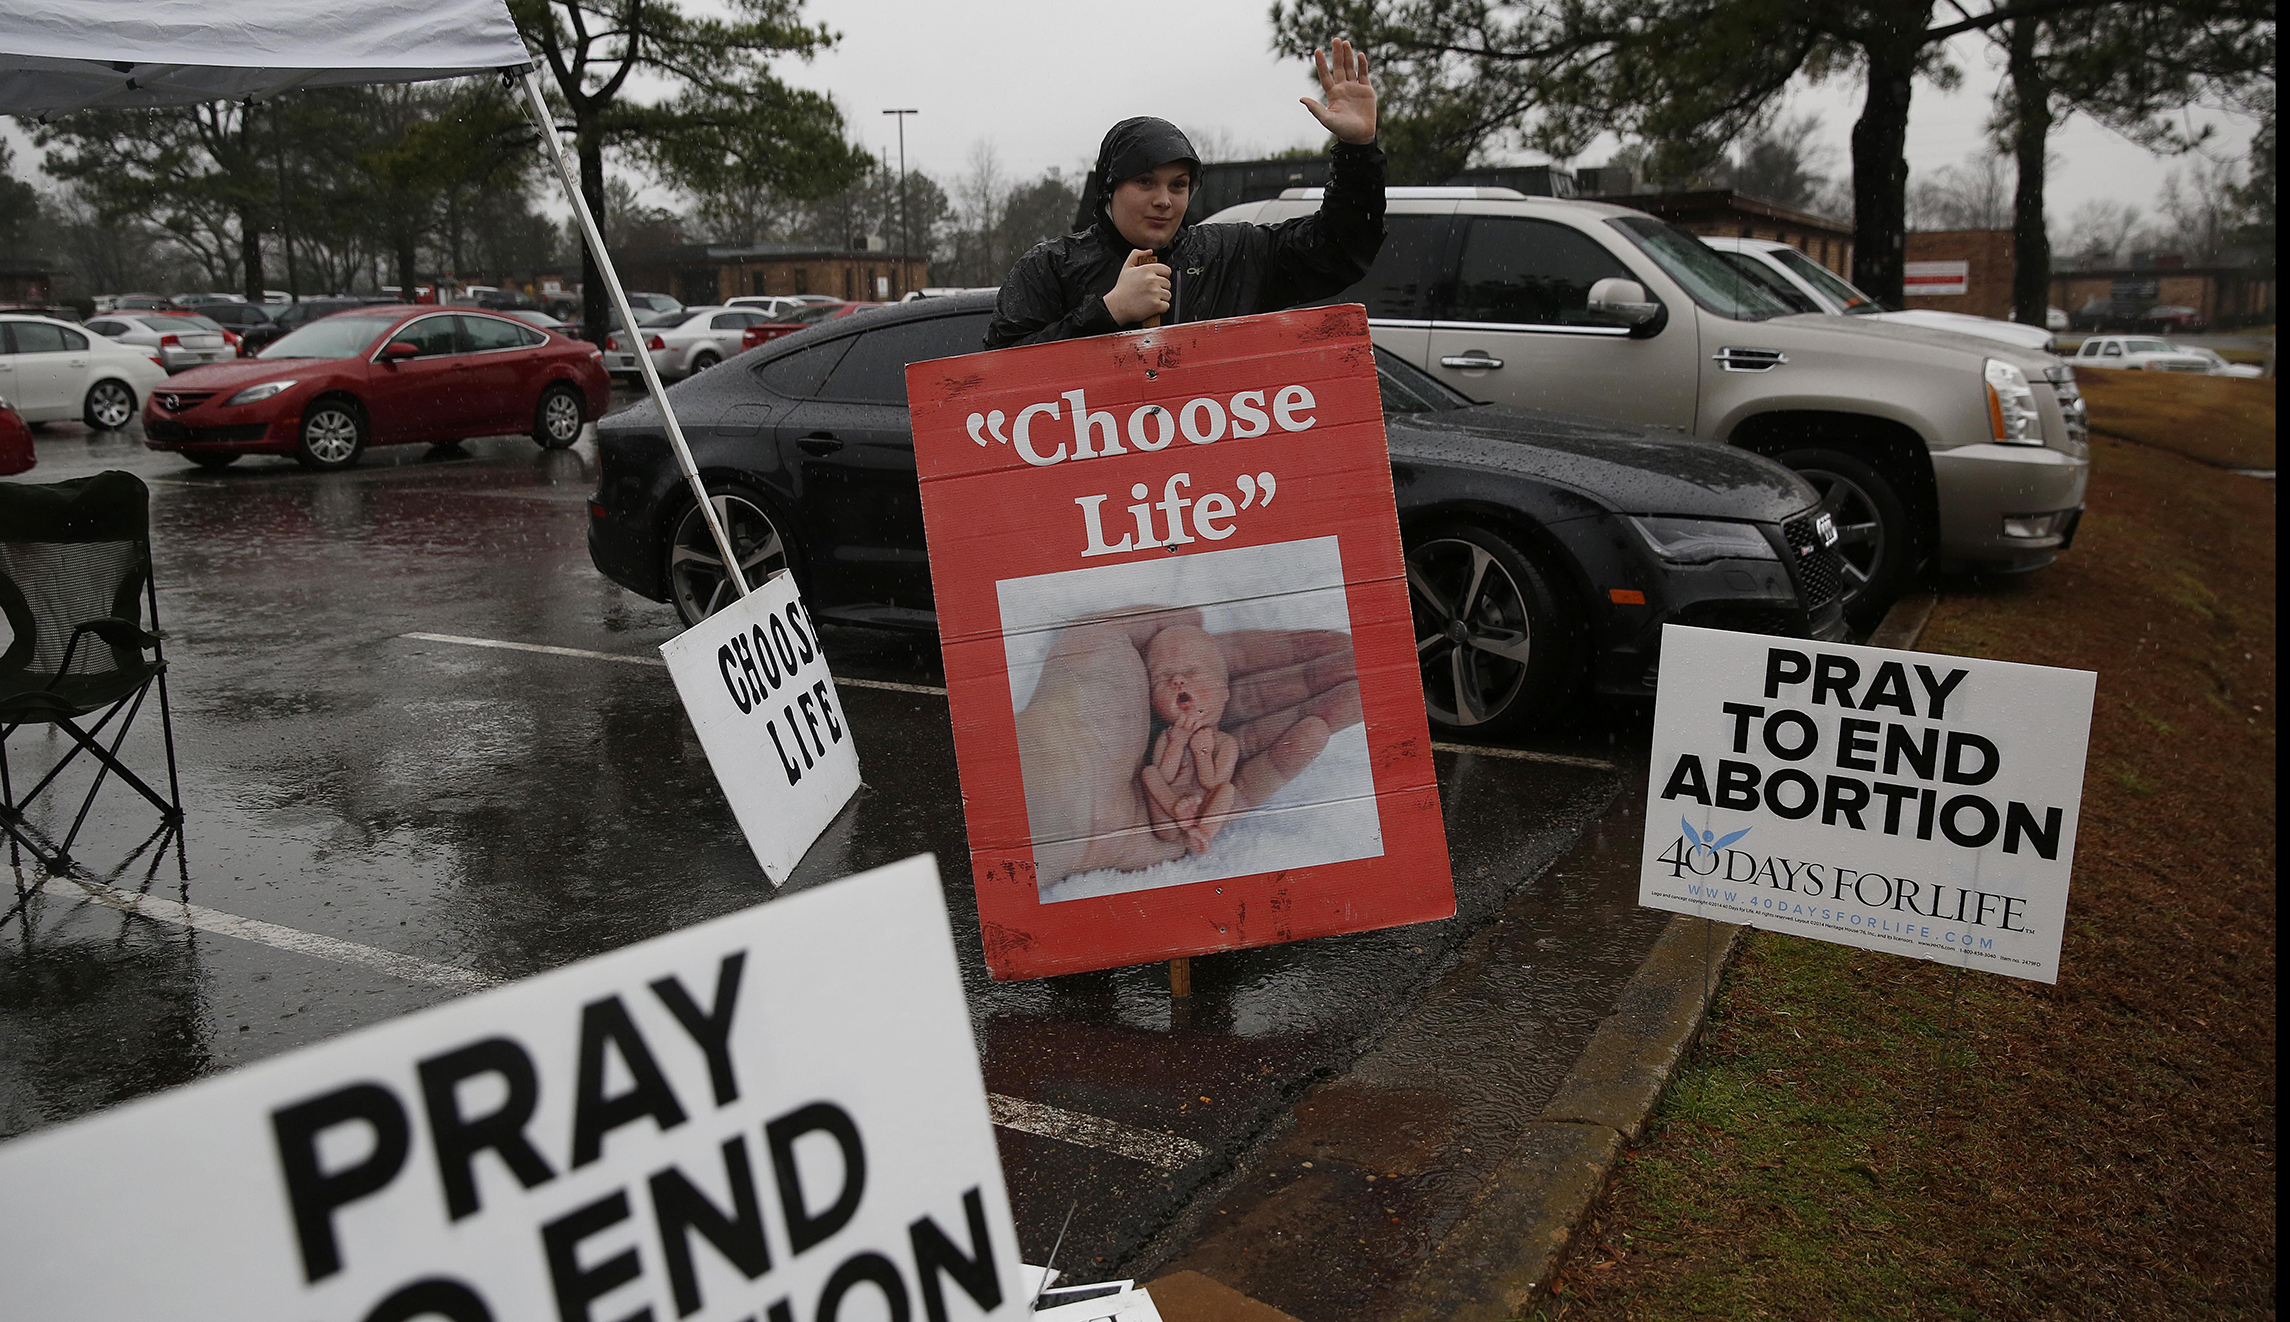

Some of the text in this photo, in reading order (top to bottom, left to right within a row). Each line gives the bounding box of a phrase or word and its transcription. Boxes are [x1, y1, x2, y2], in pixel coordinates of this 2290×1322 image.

[966, 384, 1317, 466] “Choose
[1074, 471, 1277, 558] Life”
[1764, 647, 1970, 720] PRAY
[766, 679, 843, 787] LIFE
[1722, 702, 2001, 786] TO END
[1660, 754, 2063, 861] ABORTION
[1656, 835, 1720, 879] 40
[1722, 848, 1825, 896] DAYS
[1831, 867, 1926, 916] FOR
[1669, 893, 1688, 902] concept
[1686, 897, 1709, 906] copyright
[1760, 910, 1774, 918] rights
[1793, 917, 1810, 925] Layout
[1823, 922, 1844, 931] Heritage
[1688, 884, 1993, 949] WWW.40DAYSFORLIFE.COM
[272, 948, 750, 1286] PRAY
[540, 1101, 867, 1322] END
